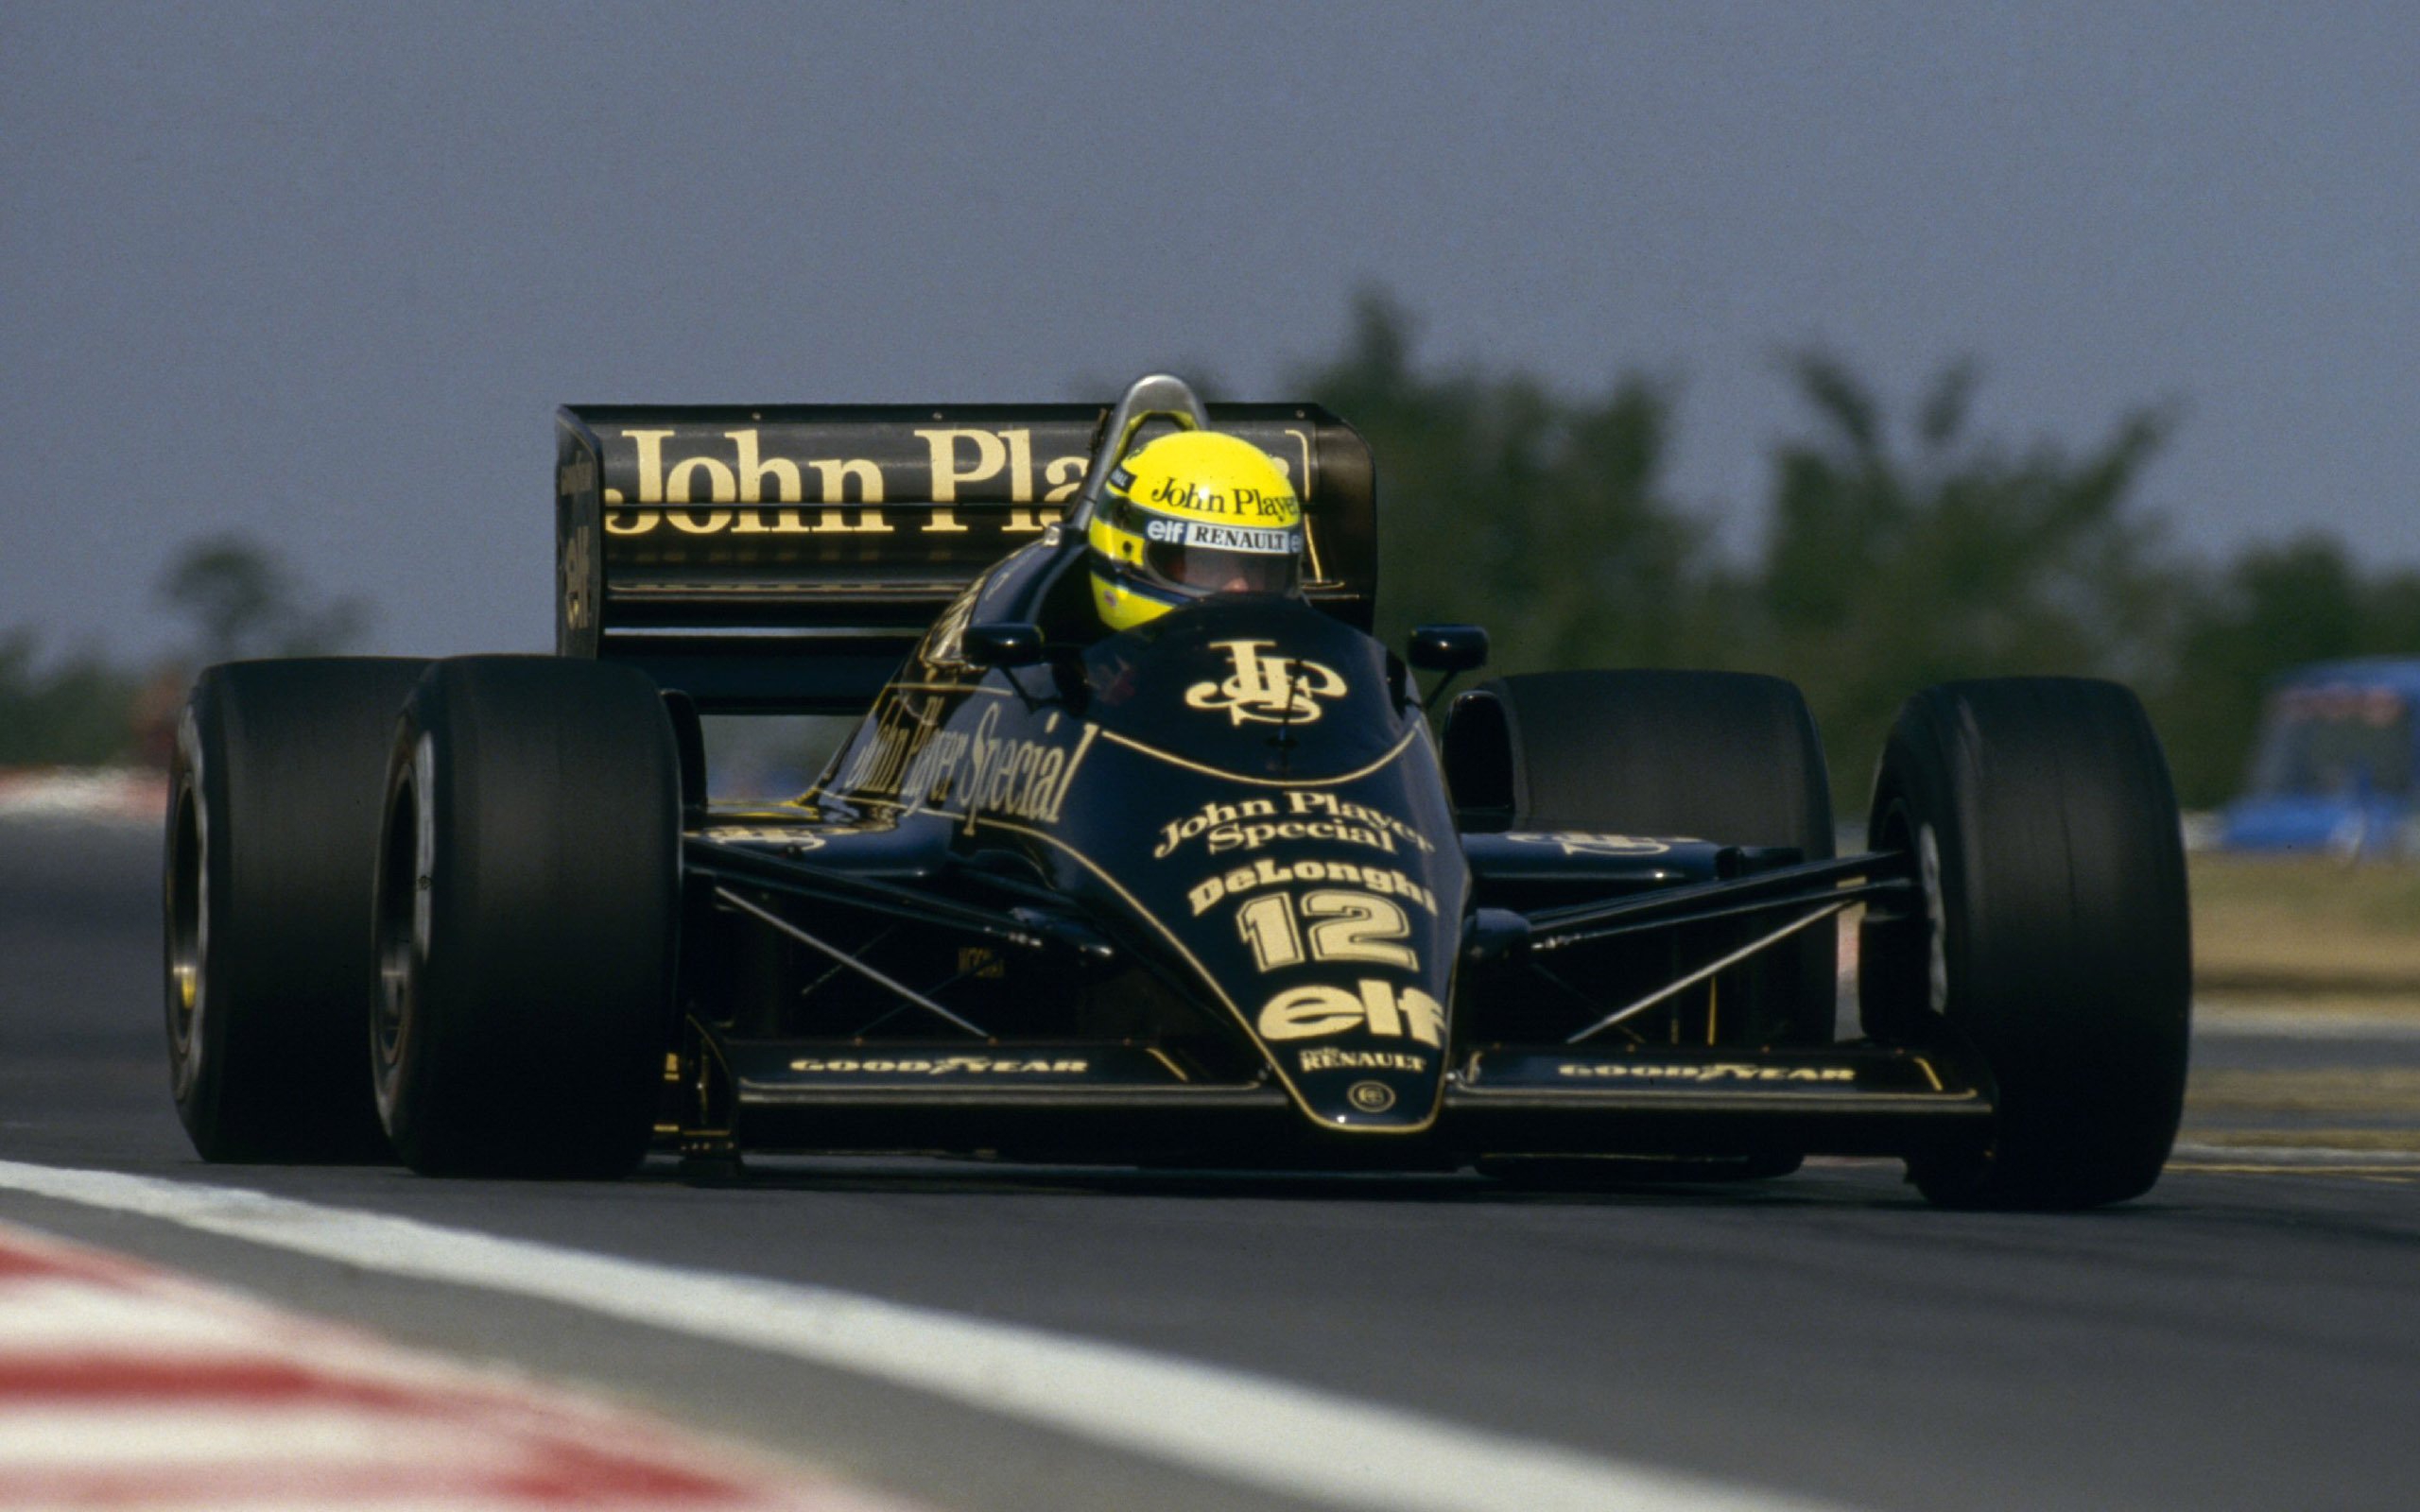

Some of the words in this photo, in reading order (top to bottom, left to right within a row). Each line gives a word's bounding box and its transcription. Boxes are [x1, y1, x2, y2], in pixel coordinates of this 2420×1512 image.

[605, 429, 894, 535] John
[913, 429, 1091, 532] Pla
[1150, 477, 1226, 514] John
[1232, 488, 1301, 522] Playe
[1147, 521, 1184, 543] elf
[1195, 525, 1285, 550] RENAULT
[957, 701, 1099, 836] Special
[1154, 802, 1278, 858] John
[1283, 791, 1436, 853] Player
[1208, 817, 1399, 855] Special
[1187, 858, 1438, 917] DeLonghi
[1236, 889, 1420, 973] 12
[1257, 978, 1446, 1050] elf
[1300, 1047, 1426, 1074] RENAULT
